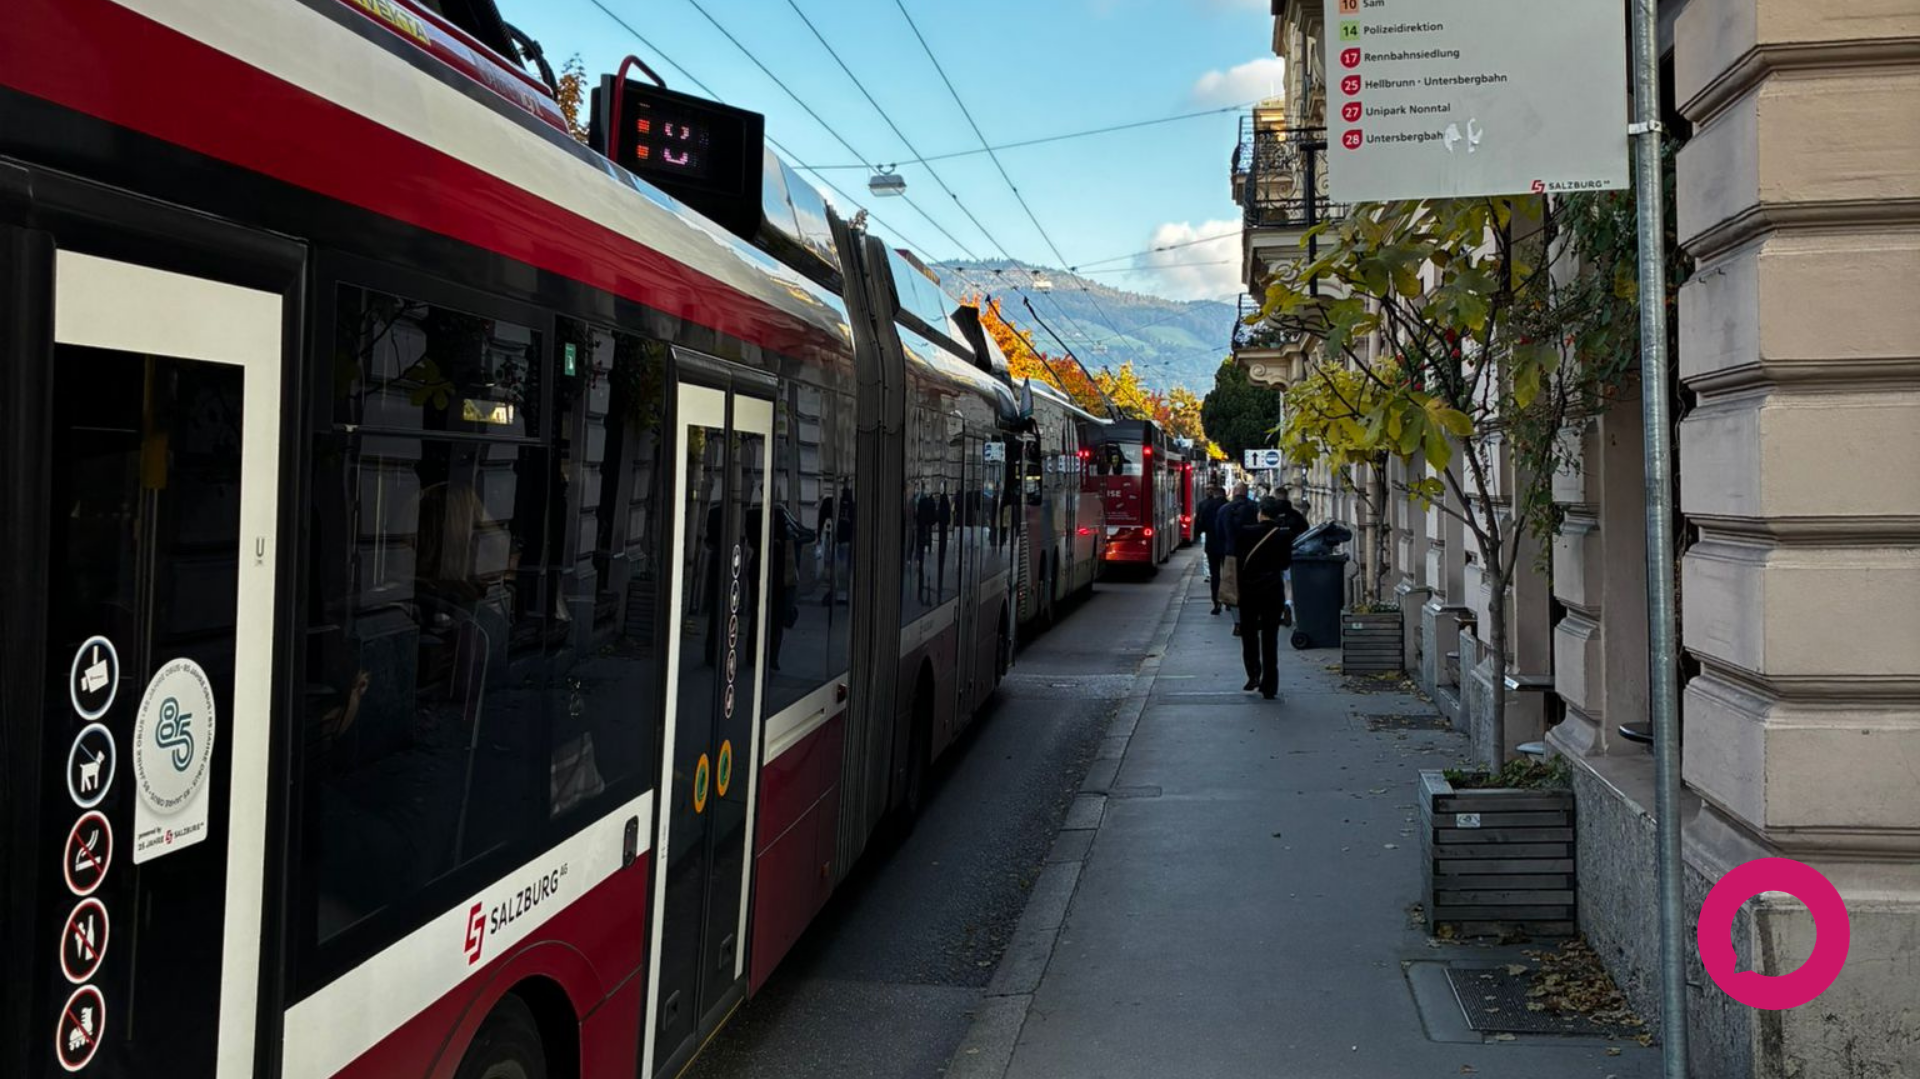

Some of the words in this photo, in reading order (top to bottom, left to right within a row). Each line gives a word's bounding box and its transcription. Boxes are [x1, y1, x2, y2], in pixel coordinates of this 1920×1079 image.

[1343, 0, 1357, 9] 10
[1363, 0, 1385, 8] Sam
[1343, 26, 1358, 37] 14
[1363, 22, 1444, 35] Polizeidirektion
[1344, 53, 1358, 63] 17
[1364, 49, 1460, 62] Rennbahnsiedlung
[1344, 80, 1359, 91] 25
[1365, 79, 1416, 89] Hellbrunn
[1424, 74, 1508, 86] Untersbergbahn
[1345, 106, 1359, 118] 27
[1365, 105, 1407, 119] Unipark
[1409, 103, 1451, 115] Nonntal
[1345, 134, 1360, 145] 28
[1366, 131, 1445, 144] Untersbergbah
[1548, 180, 1602, 190] SALZBURG
[155, 697, 194, 772] 85
[490, 869, 559, 935] SALZBURG
